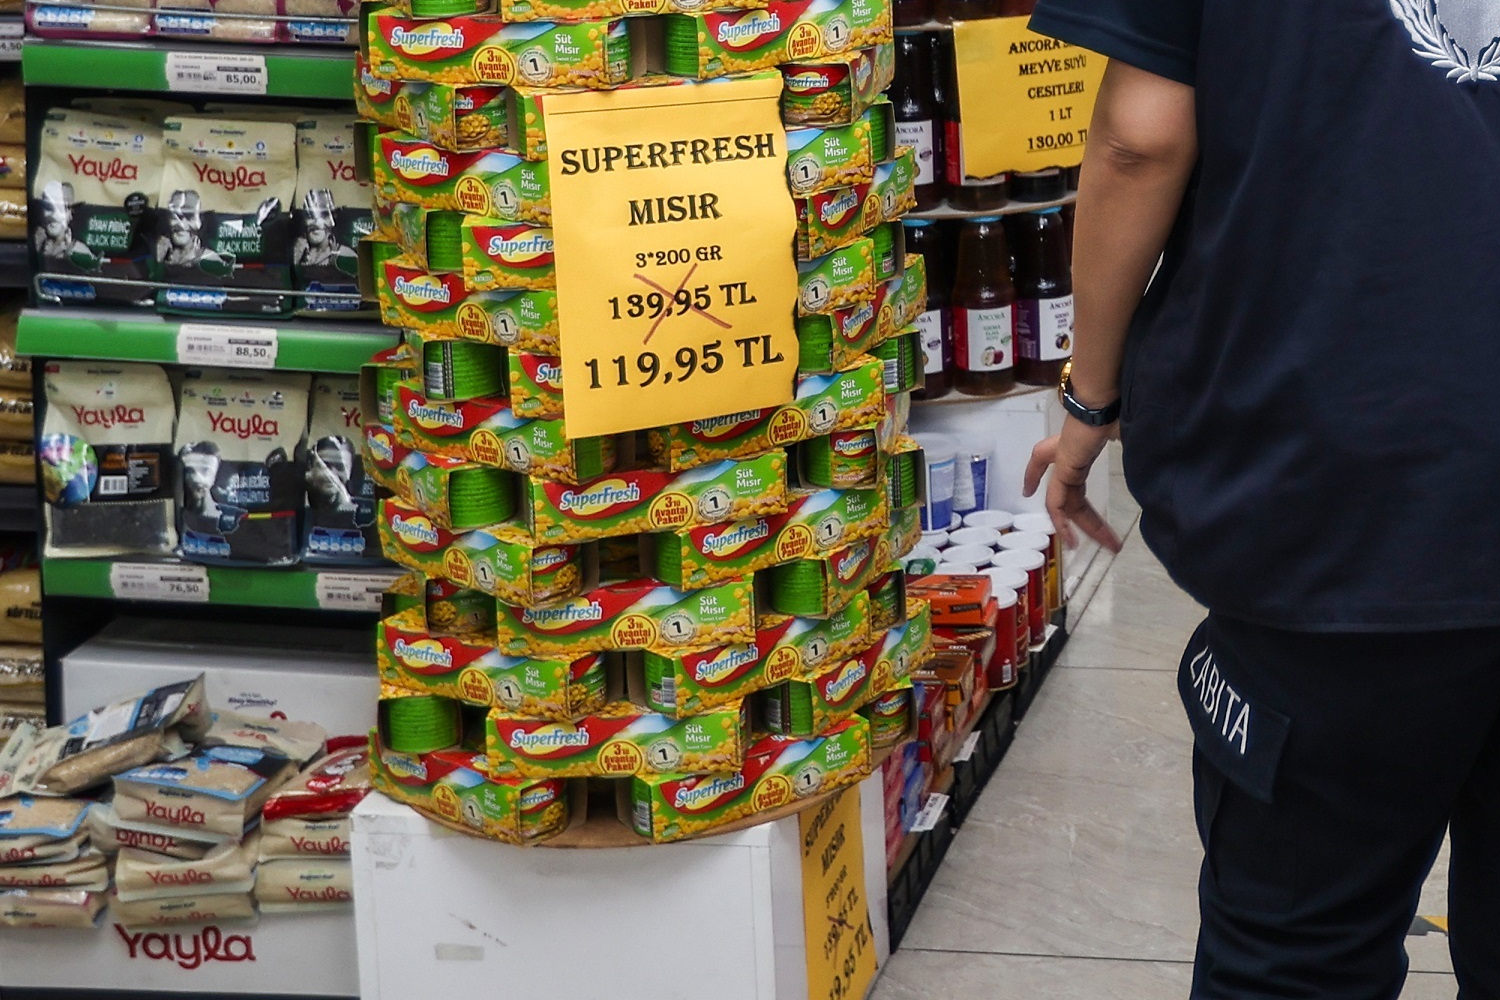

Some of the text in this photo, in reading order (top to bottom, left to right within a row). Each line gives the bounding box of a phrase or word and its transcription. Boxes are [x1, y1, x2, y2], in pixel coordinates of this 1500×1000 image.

[390, 27, 464, 48] SuperFresh
[555, 34, 572, 44] Süt
[718, 14, 781, 40] SuperFresh
[1009, 40, 1061, 54] ANCORA
[1019, 56, 1087, 75] MEYVE SUYU
[226, 75, 257, 86] 85,00
[1050, 108, 1072, 121] 1 LT
[561, 133, 777, 175] SUPERFRESH
[1027, 133, 1073, 150] 130,00
[68, 153, 138, 182] Yayla
[192, 161, 267, 192] Yayla
[392, 152, 449, 176] SuperFresh
[628, 193, 722, 226] MISIR
[821, 188, 858, 221] SuperFresh
[87, 235, 109, 247] BLACK
[217, 240, 240, 252] BLACK
[489, 237, 554, 256] SuperFre
[696, 245, 722, 261] GR
[395, 277, 450, 303] SuperFresh
[608, 282, 757, 320] 139,95 TL
[236, 347, 267, 358] 88,50
[585, 335, 784, 389] 119,95 TL
[71, 403, 145, 428] Yayla
[207, 411, 278, 439] Yayla
[410, 401, 463, 428] SuperFresh
[560, 482, 640, 511] SuperFresh
[392, 515, 438, 545] SuperFresh
[703, 522, 769, 554] SuperFresh
[169, 584, 199, 594] 76,50
[523, 603, 602, 624] SuperFresh
[395, 639, 452, 666] SuperFresh
[696, 645, 758, 680] SuperFresh
[826, 661, 866, 694] SuperFresh
[511, 730, 589, 747] SuperFresh
[676, 772, 744, 808] SuperFresh
[144, 800, 205, 825] Yayla
[147, 869, 215, 885] Yayla
[114, 923, 256, 970] Yayla
